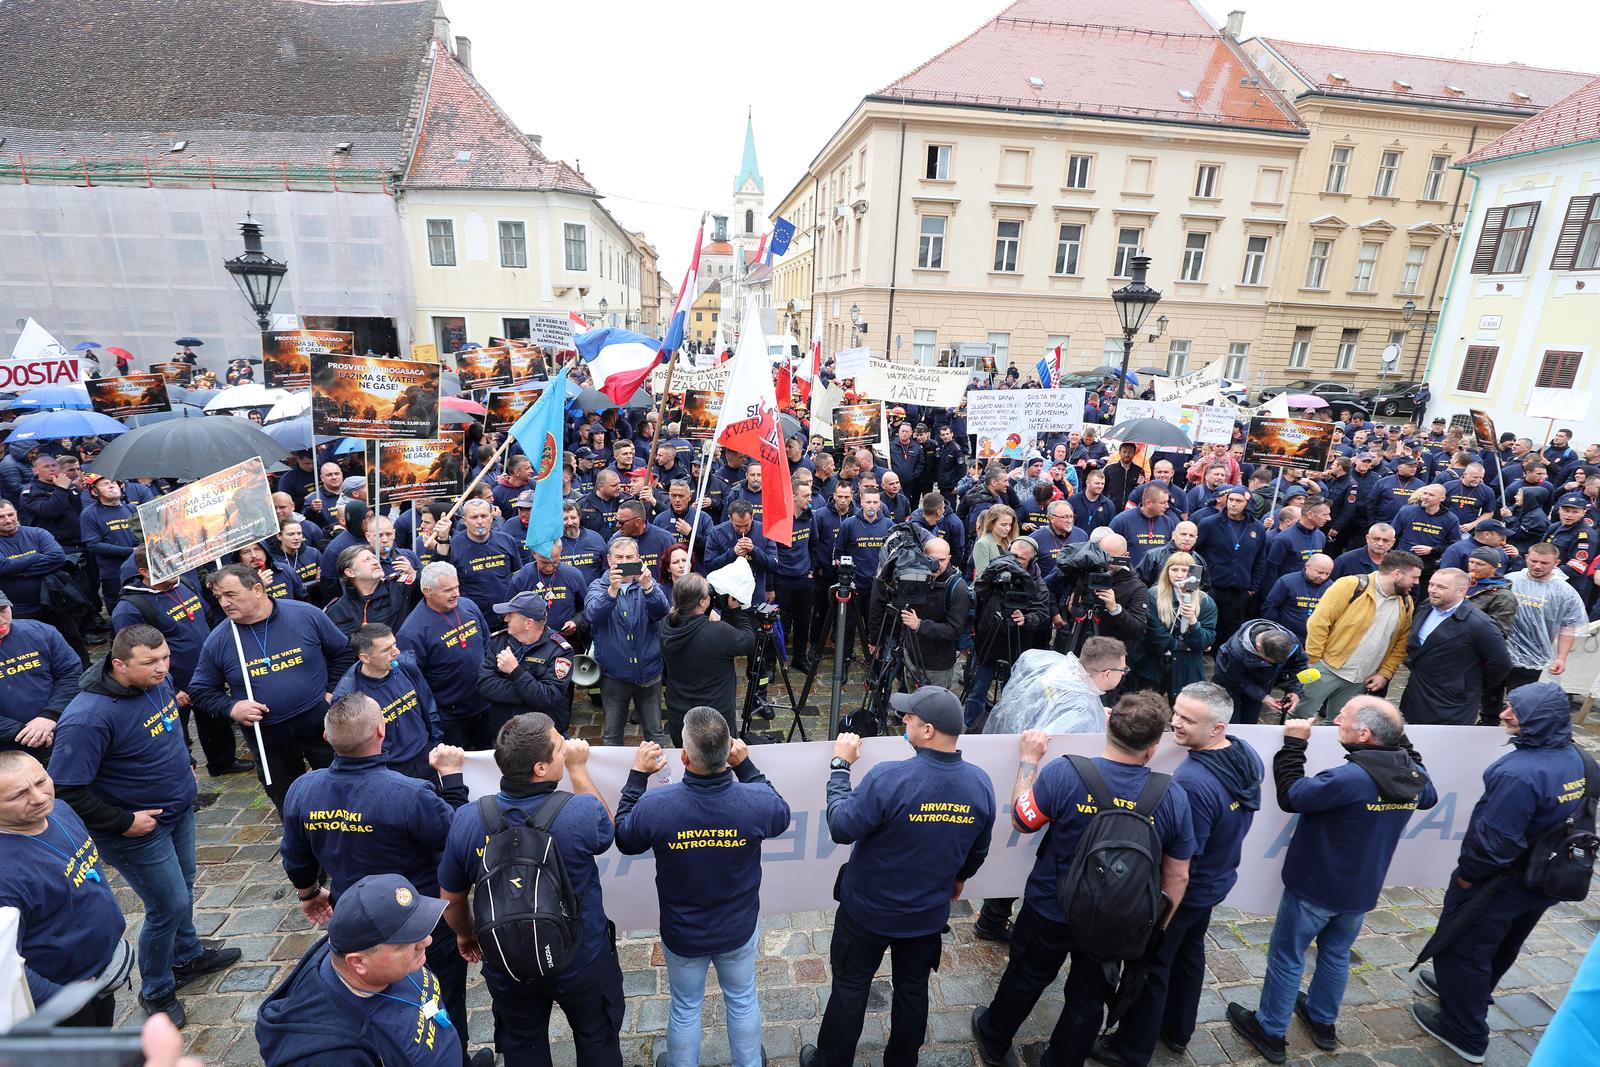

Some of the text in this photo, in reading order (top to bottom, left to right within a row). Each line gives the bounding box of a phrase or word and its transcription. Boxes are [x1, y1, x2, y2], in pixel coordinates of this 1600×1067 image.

[328, 362, 366, 372] PROSVJED
[376, 374, 386, 382] SE
[388, 376, 417, 384] VATRE
[655, 369, 693, 382] POŠUJETE
[886, 372, 940, 383] VATROGASACA
[372, 382, 398, 390] GASE!
[672, 380, 725, 391] ZAKONE
[898, 386, 937, 402] ANTE
[472, 560, 505, 572] NE GASE
[272, 589, 288, 598] ASE
[172, 611, 187, 622] NE
[446, 636, 459, 648] NE
[17, 651, 40, 661] VATRE
[245, 658, 264, 667] LAŽI
[280, 648, 302, 657] VATRE
[6, 659, 41, 675] GASE
[250, 656, 304, 677] NE GASE
[150, 722, 164, 738] NE
[920, 802, 970, 813] HRVATSKI
[310, 808, 362, 822] HRVATSKI
[908, 814, 976, 824] VATROGASAC
[304, 822, 374, 833] VATROGASAC
[677, 829, 738, 840] HRVATSKI
[668, 839, 747, 850] VATROGASAC
[426, 974, 440, 1050] NE ASE
